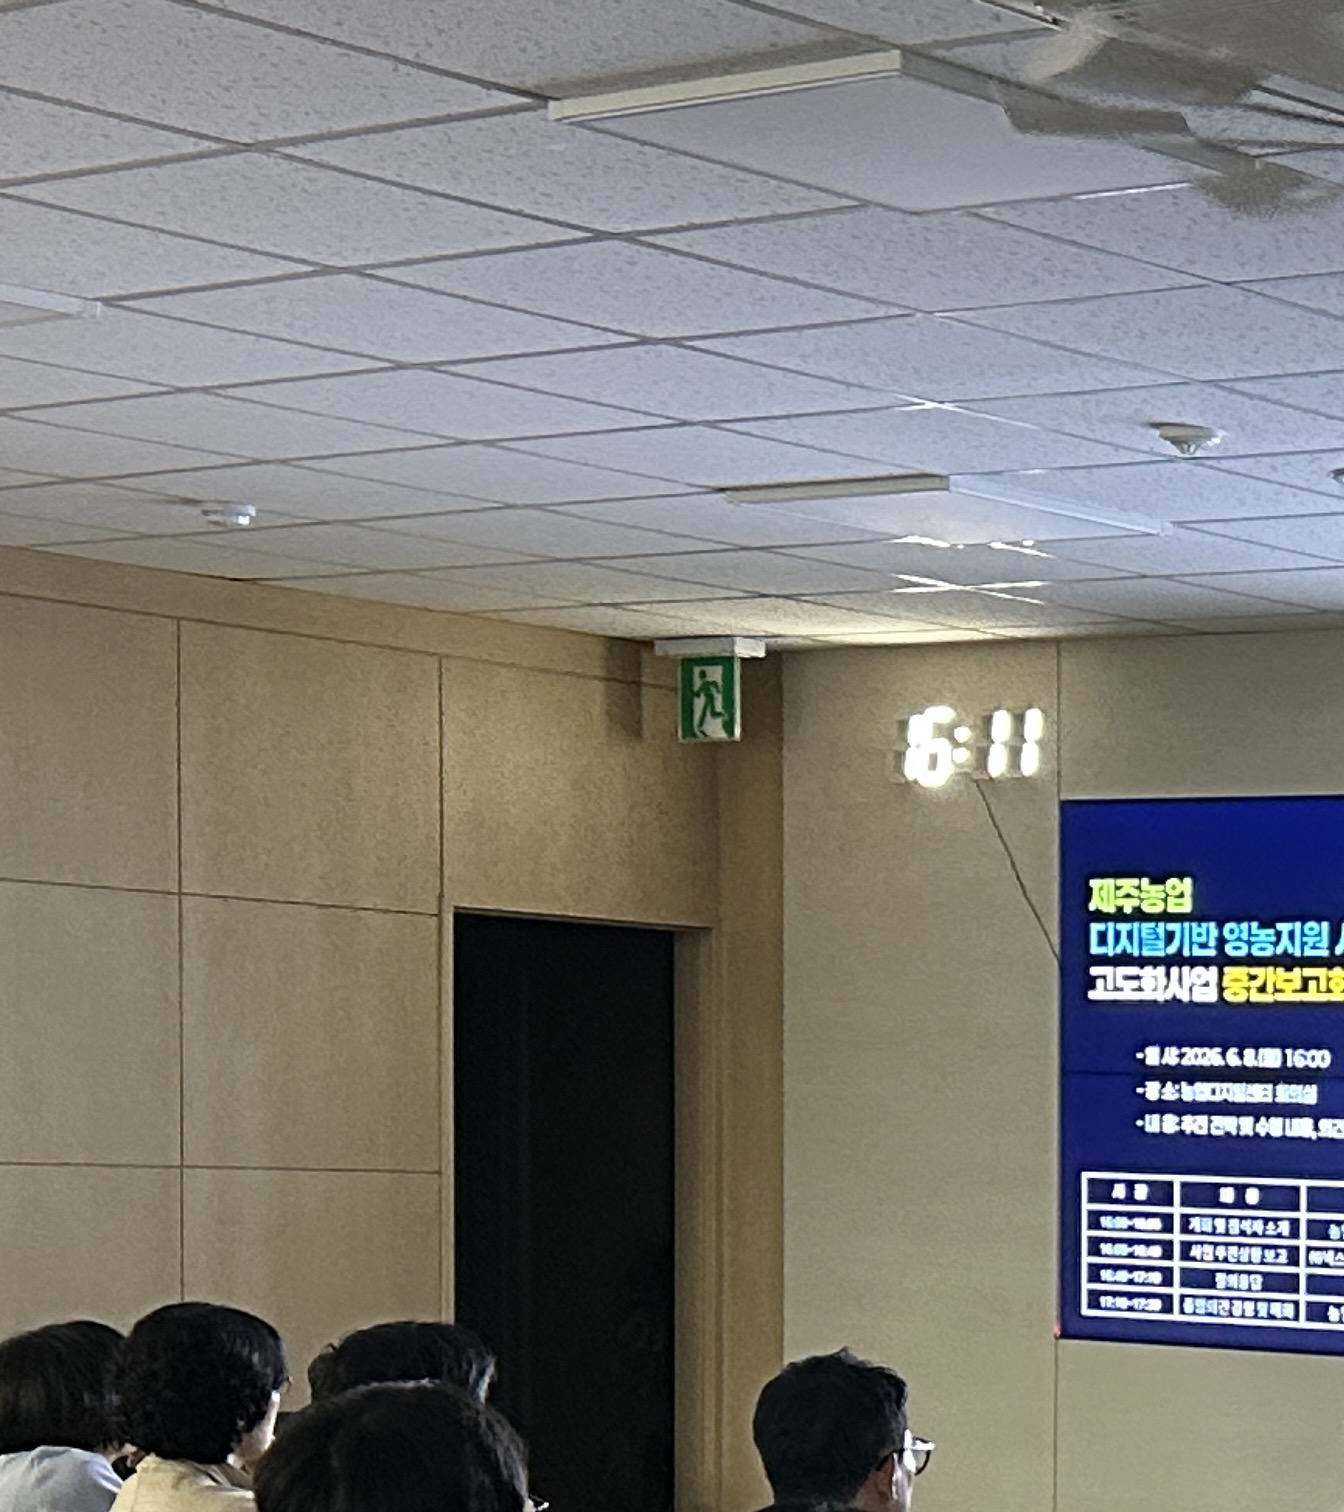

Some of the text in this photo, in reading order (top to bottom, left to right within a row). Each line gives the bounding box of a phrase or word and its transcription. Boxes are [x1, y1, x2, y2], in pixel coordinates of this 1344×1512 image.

[1088, 877, 1193, 914] 제주농업
[1089, 921, 1217, 958] 디지털기반
[1223, 920, 1330, 958] 영농지원
[1087, 965, 1218, 1002] 고도화사업
